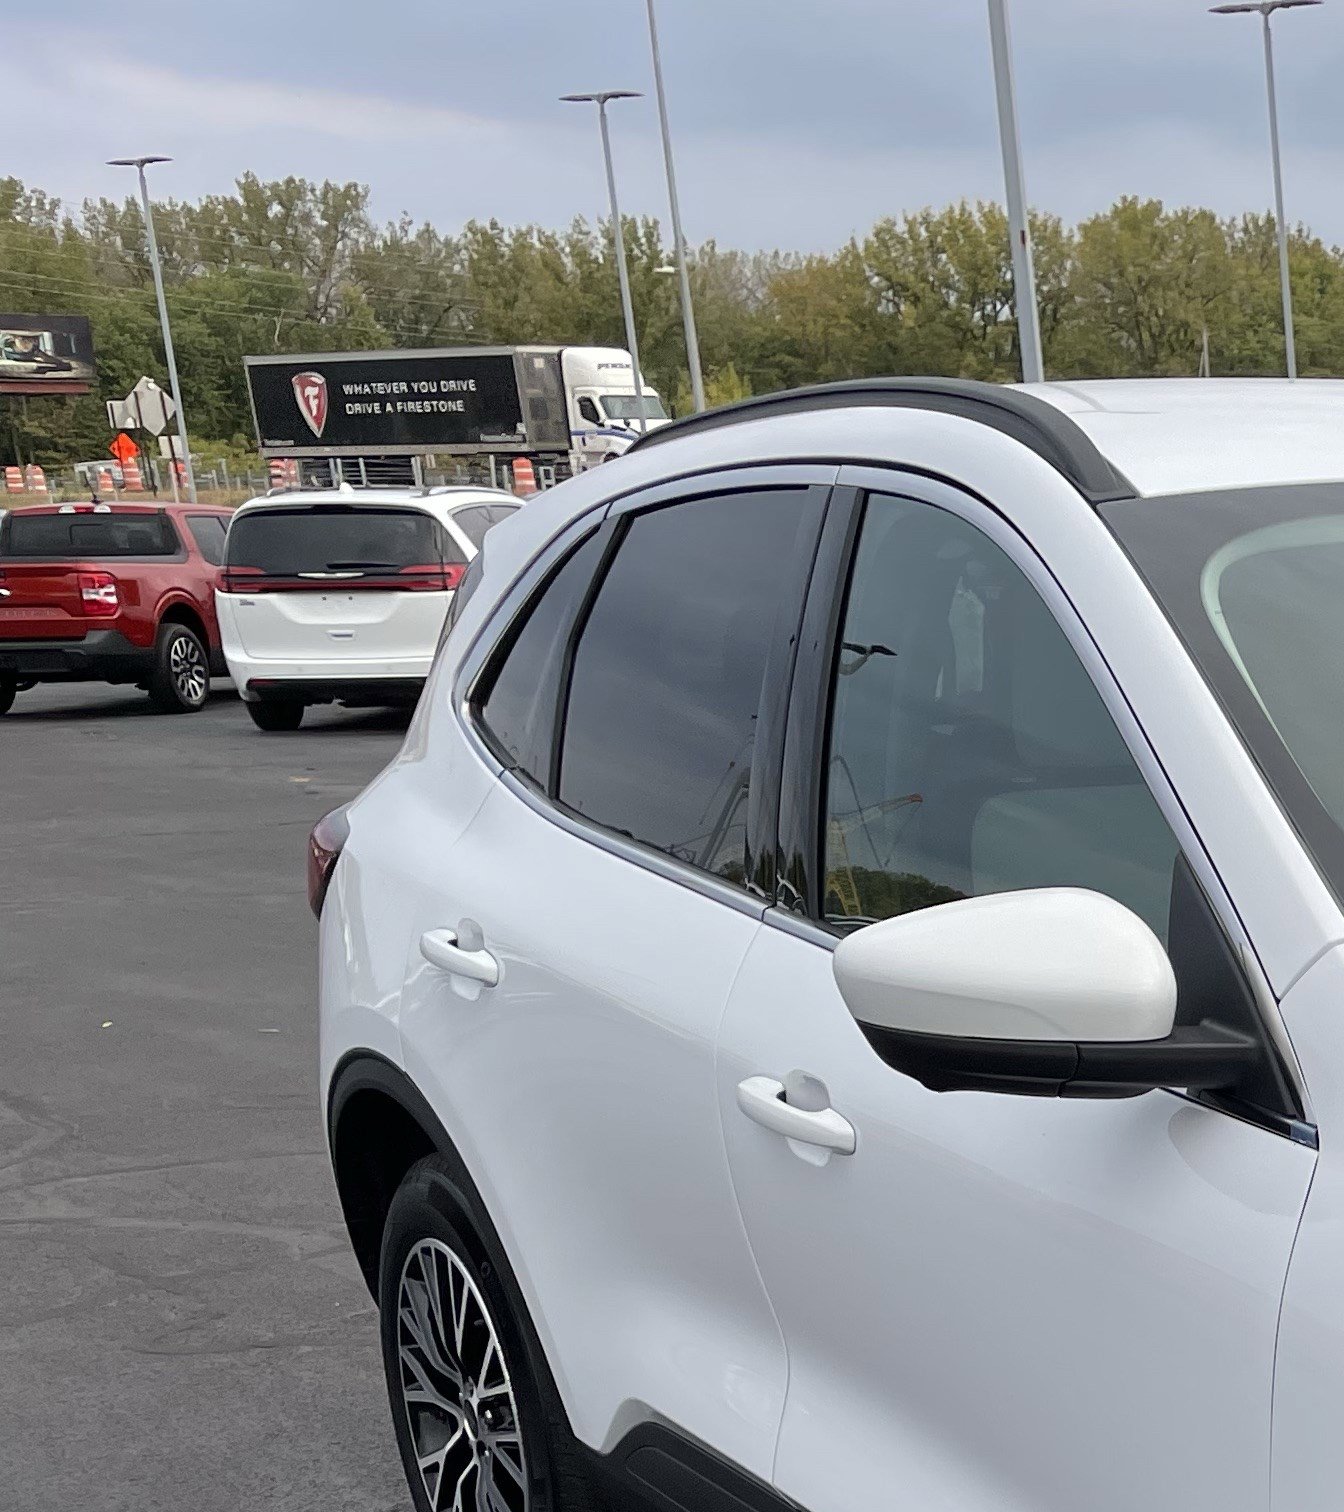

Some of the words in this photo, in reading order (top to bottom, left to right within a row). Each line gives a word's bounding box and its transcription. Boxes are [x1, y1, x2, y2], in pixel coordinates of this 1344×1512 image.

[342, 382, 408, 395] WHATEVER
[411, 381, 437, 393] YOU
[440, 379, 477, 393] DRIVE
[345, 402, 382, 415] DRIVE
[385, 402, 394, 413] A
[396, 400, 465, 413] FIRESTONE
